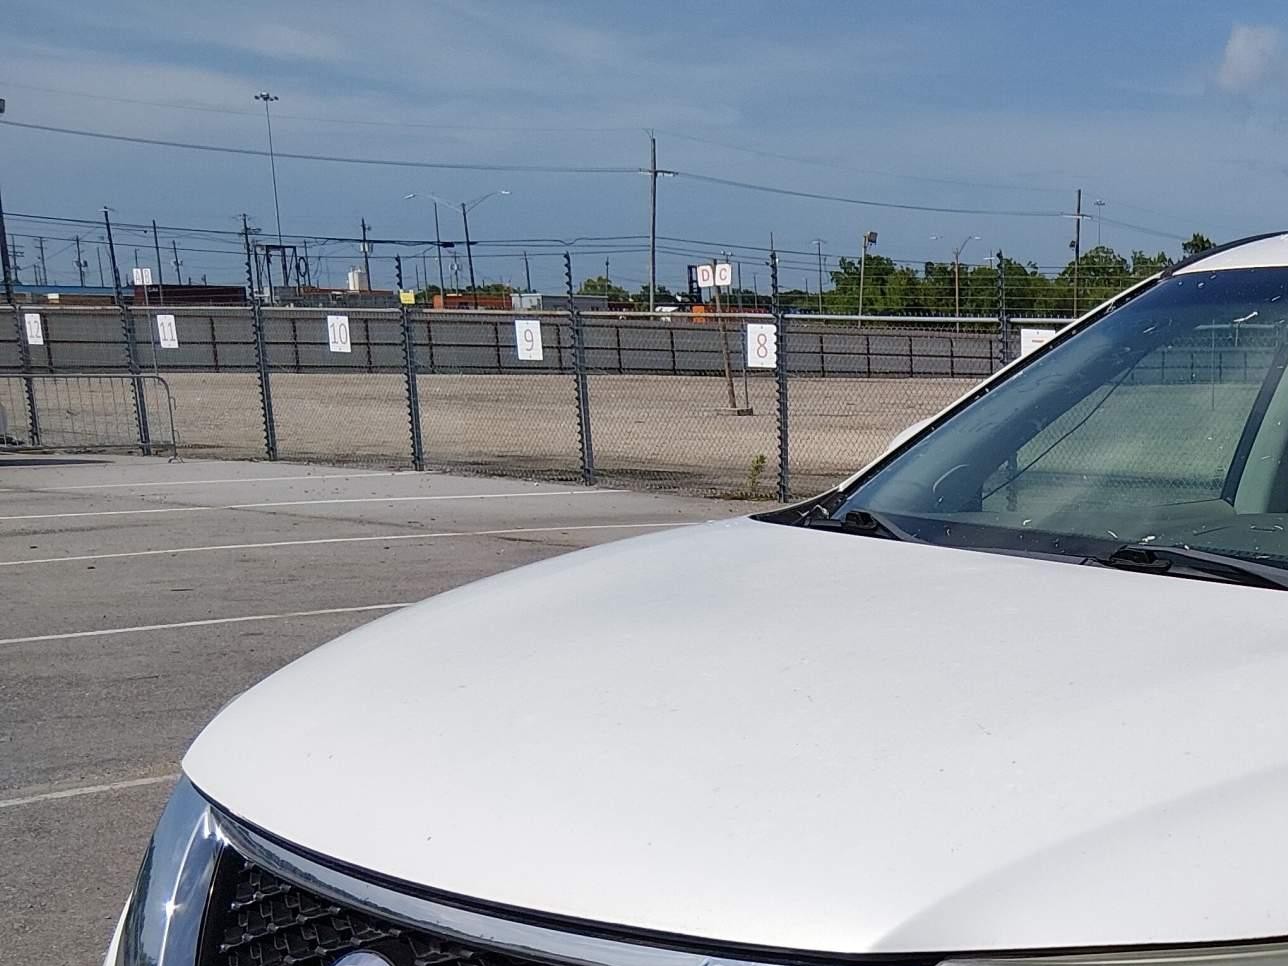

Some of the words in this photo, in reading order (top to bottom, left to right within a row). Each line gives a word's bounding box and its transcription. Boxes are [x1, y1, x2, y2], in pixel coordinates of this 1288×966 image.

[136, 270, 143, 284] A
[702, 269, 710, 282] D
[719, 268, 728, 281] C
[27, 320, 42, 338] 12
[160, 321, 176, 341] 11
[330, 323, 348, 345] 10
[524, 329, 534, 351] 9
[756, 333, 768, 358] 8
